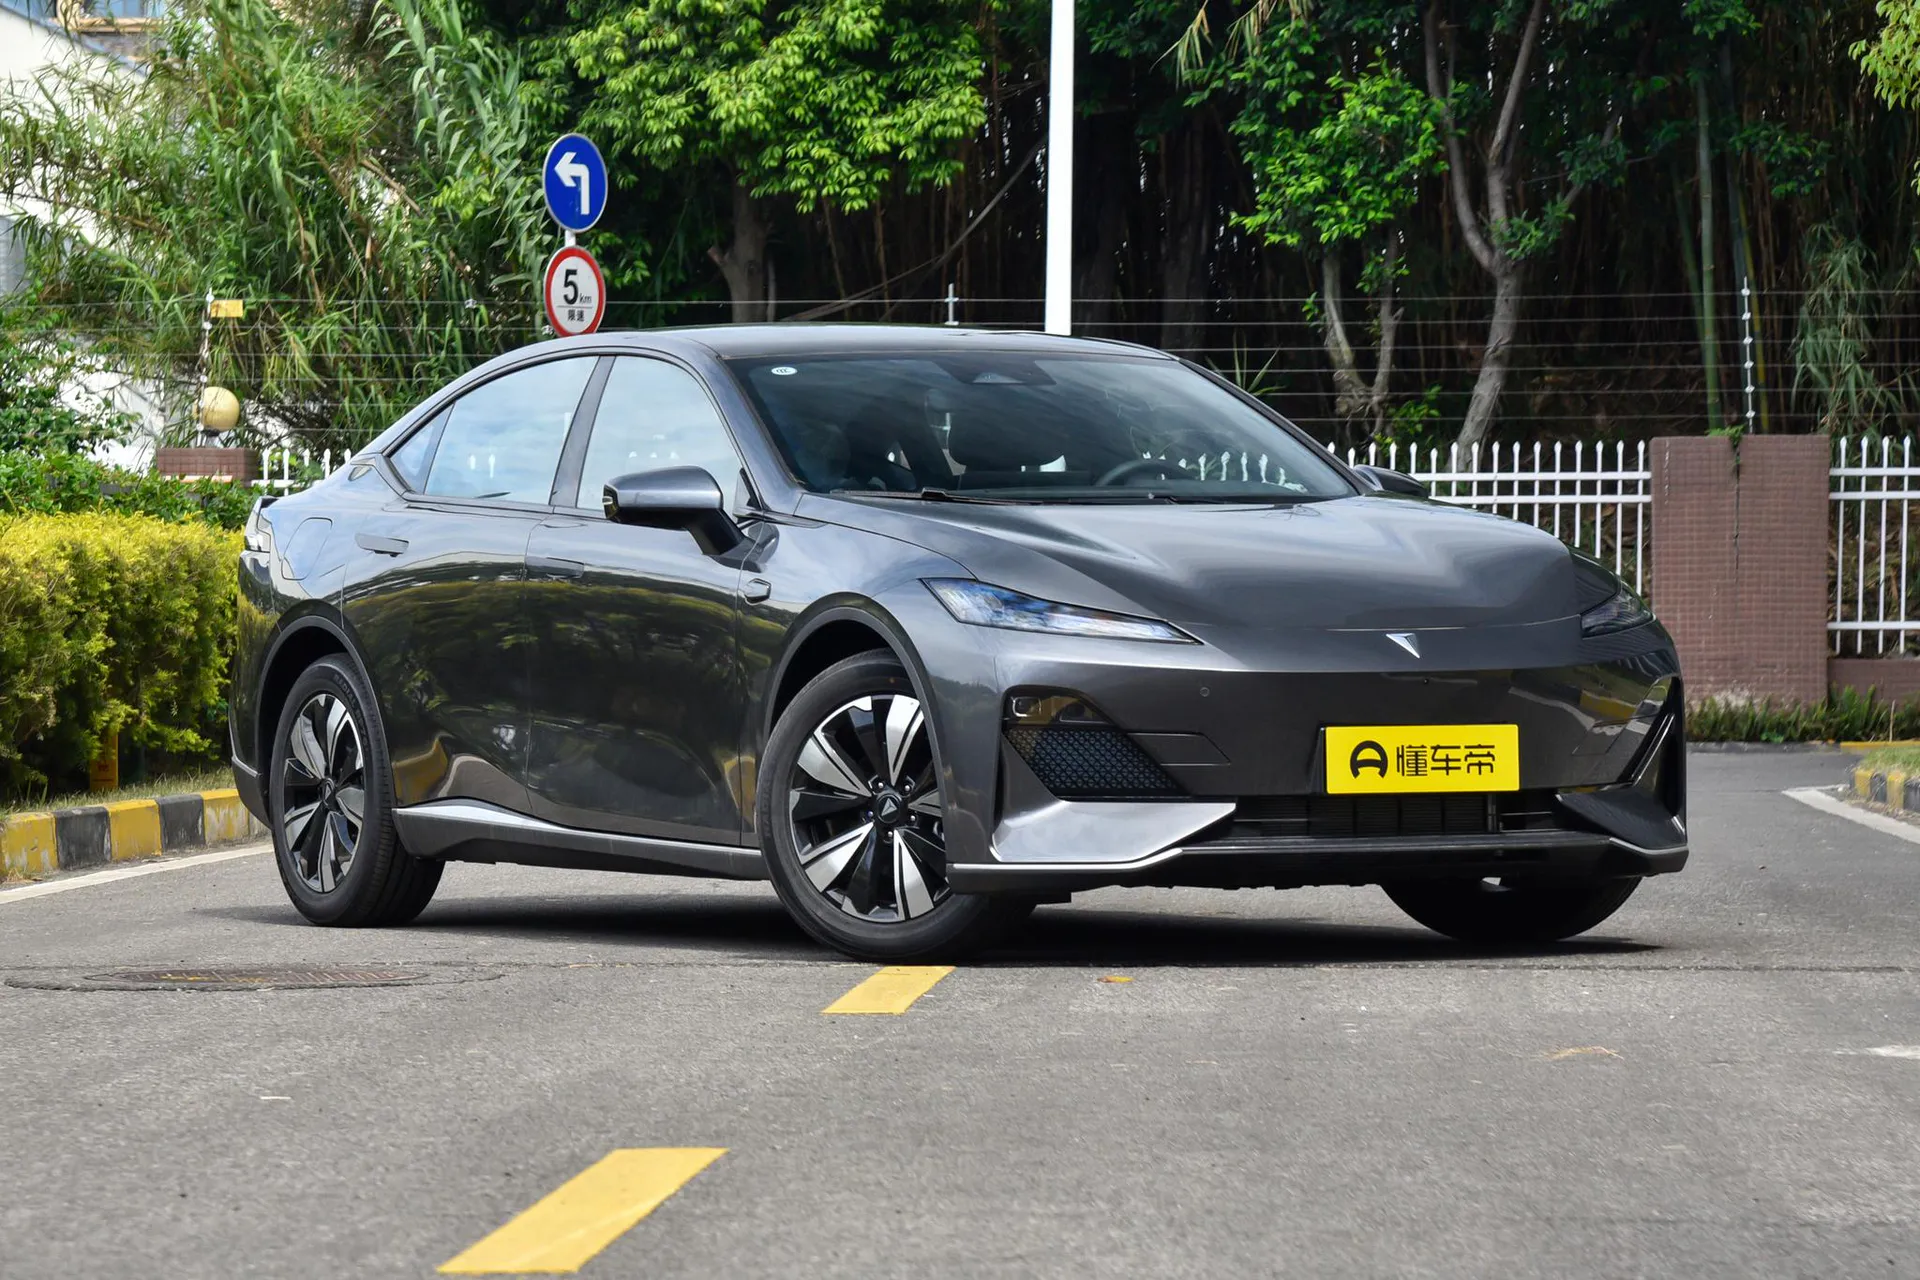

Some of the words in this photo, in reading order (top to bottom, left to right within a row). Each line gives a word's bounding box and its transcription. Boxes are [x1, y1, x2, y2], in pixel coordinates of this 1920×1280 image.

[567, 309, 585, 322] 限速
[1396, 744, 1496, 777] 懂车帝
